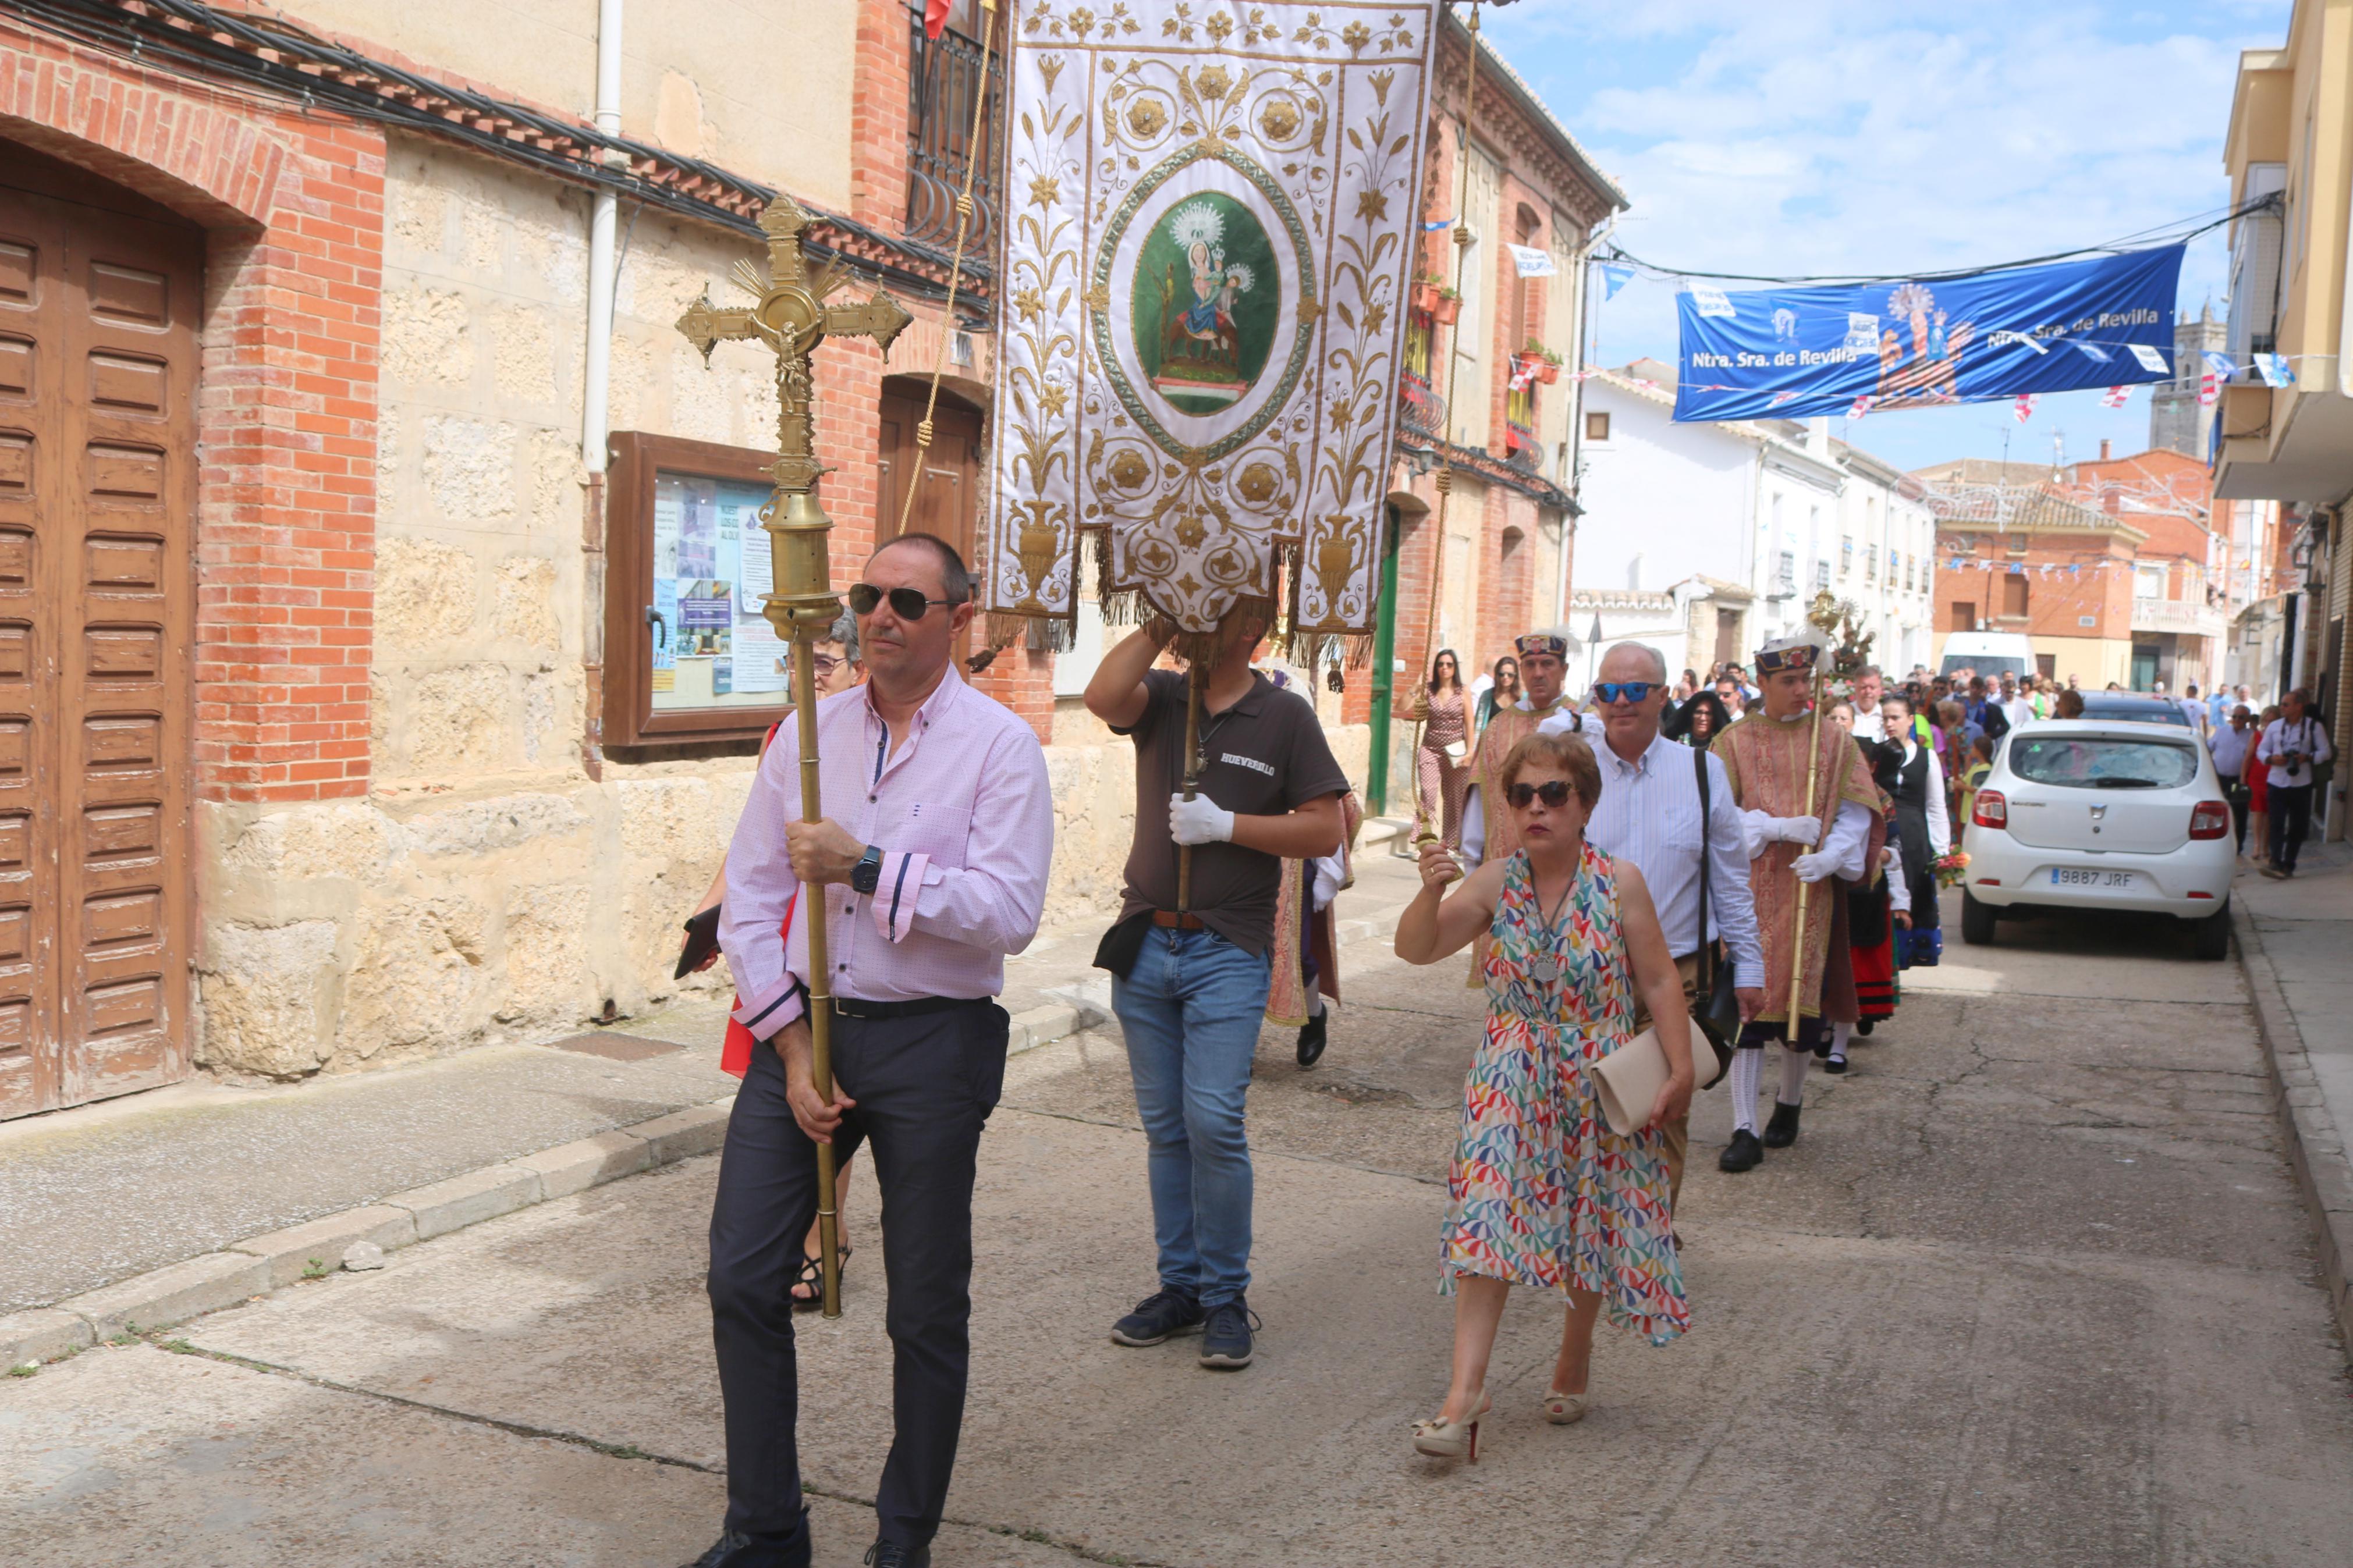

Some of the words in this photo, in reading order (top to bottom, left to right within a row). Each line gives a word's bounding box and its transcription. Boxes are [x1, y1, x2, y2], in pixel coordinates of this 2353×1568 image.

[2035, 324, 2068, 338] Sra.
[2072, 318, 2094, 332] de
[2099, 308, 2158, 328] Revilla
[1692, 352, 1734, 368] Ntra.
[1737, 351, 1770, 367] Sra.
[1774, 350, 1796, 367] de
[1220, 752, 1275, 776] HUEVERILLO
[2061, 870, 2099, 885] 9887
[2103, 873, 2132, 887] JRF
